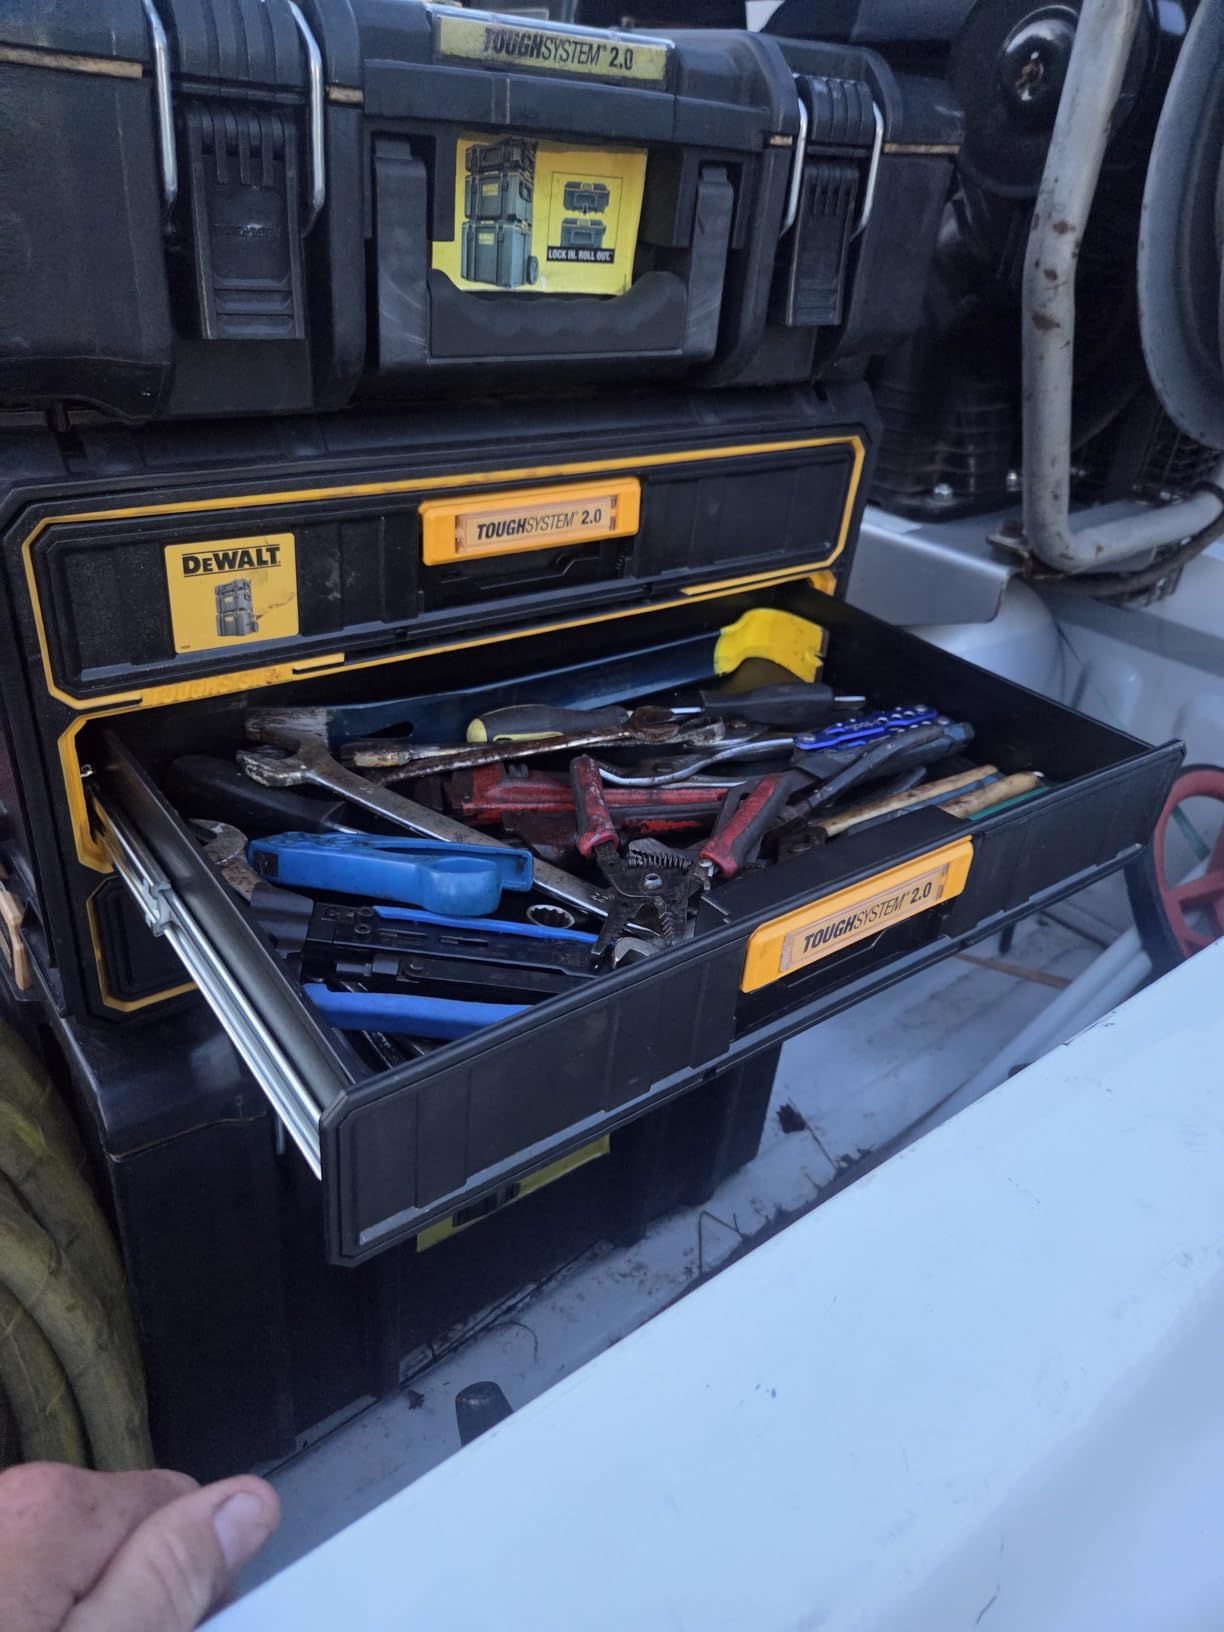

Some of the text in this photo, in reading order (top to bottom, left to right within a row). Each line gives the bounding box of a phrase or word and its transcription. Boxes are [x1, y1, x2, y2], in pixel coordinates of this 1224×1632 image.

[483, 28, 634, 70] TOUGHSYSTEM 2.0
[548, 248, 567, 260] LOCK
[578, 249, 595, 261] ROLL
[477, 508, 602, 540] TOUGHSYSTEM 2.0
[803, 882, 932, 953] TOUGHSYSTEM 2.0
